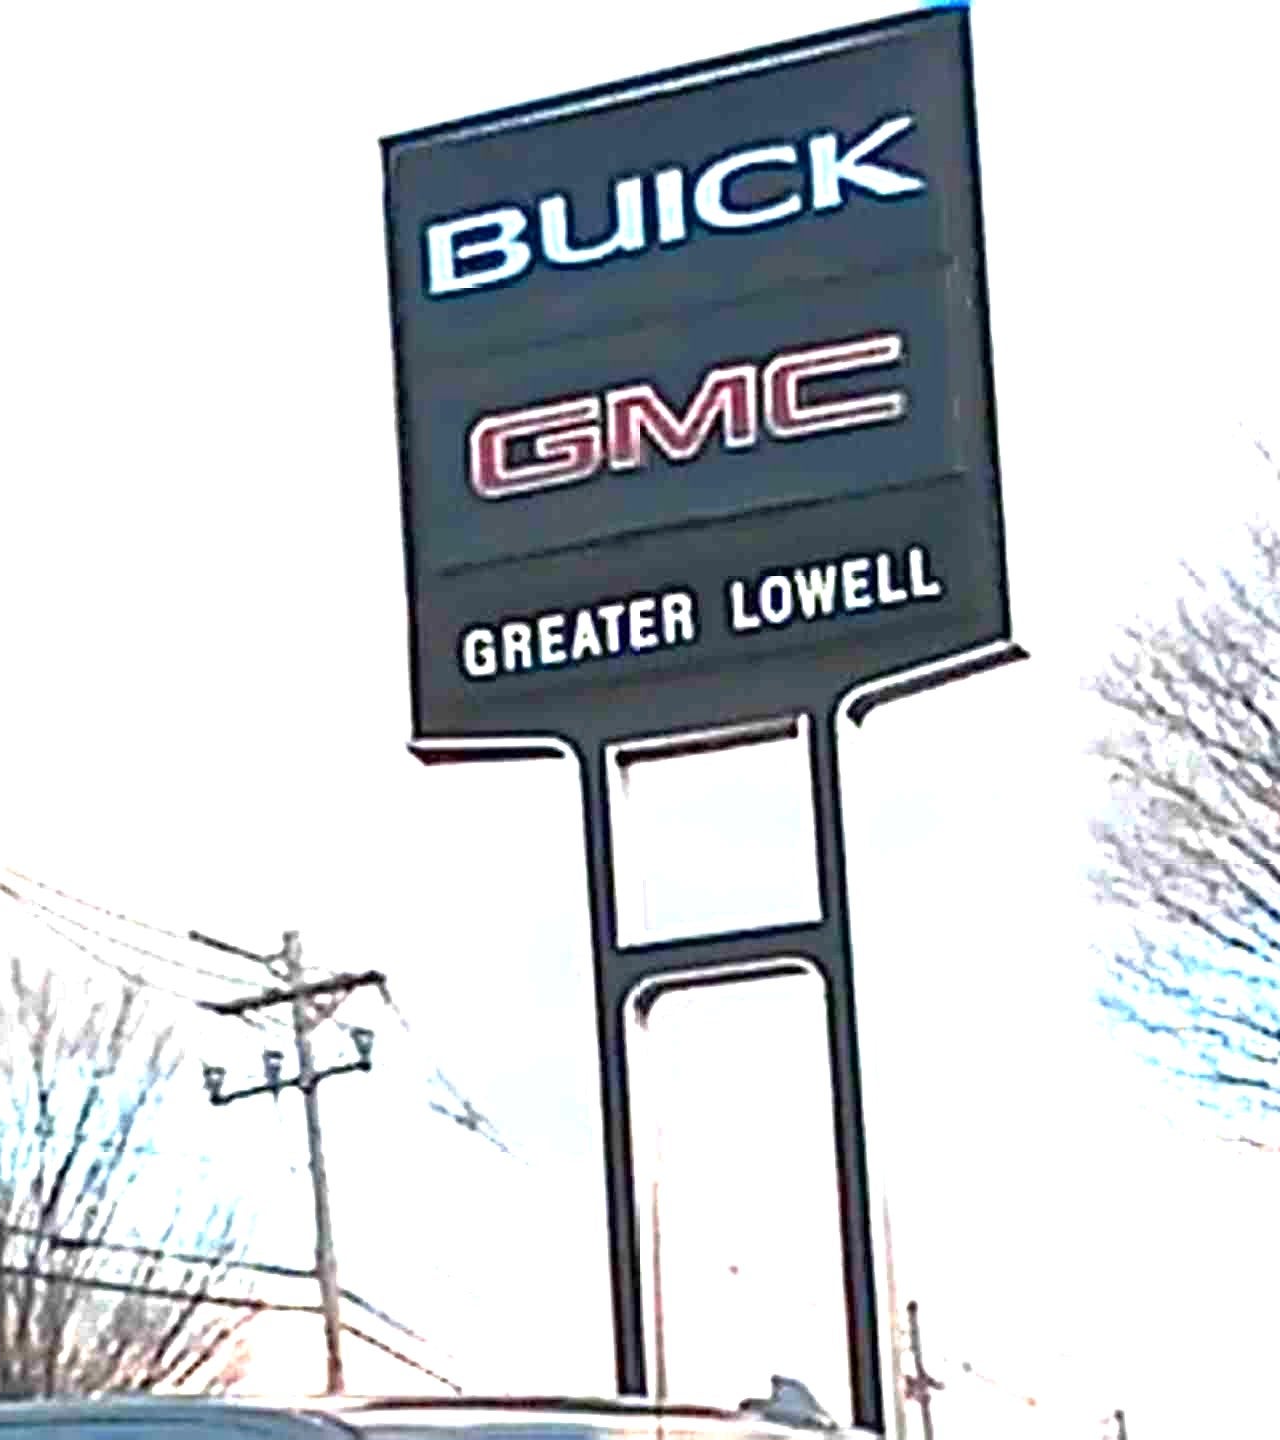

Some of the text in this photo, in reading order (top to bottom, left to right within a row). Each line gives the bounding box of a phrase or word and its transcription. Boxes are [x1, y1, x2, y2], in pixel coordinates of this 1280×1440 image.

[426, 116, 924, 294] BUICK
[469, 334, 904, 498] GMC
[463, 549, 941, 678] GREATER LOWELL
